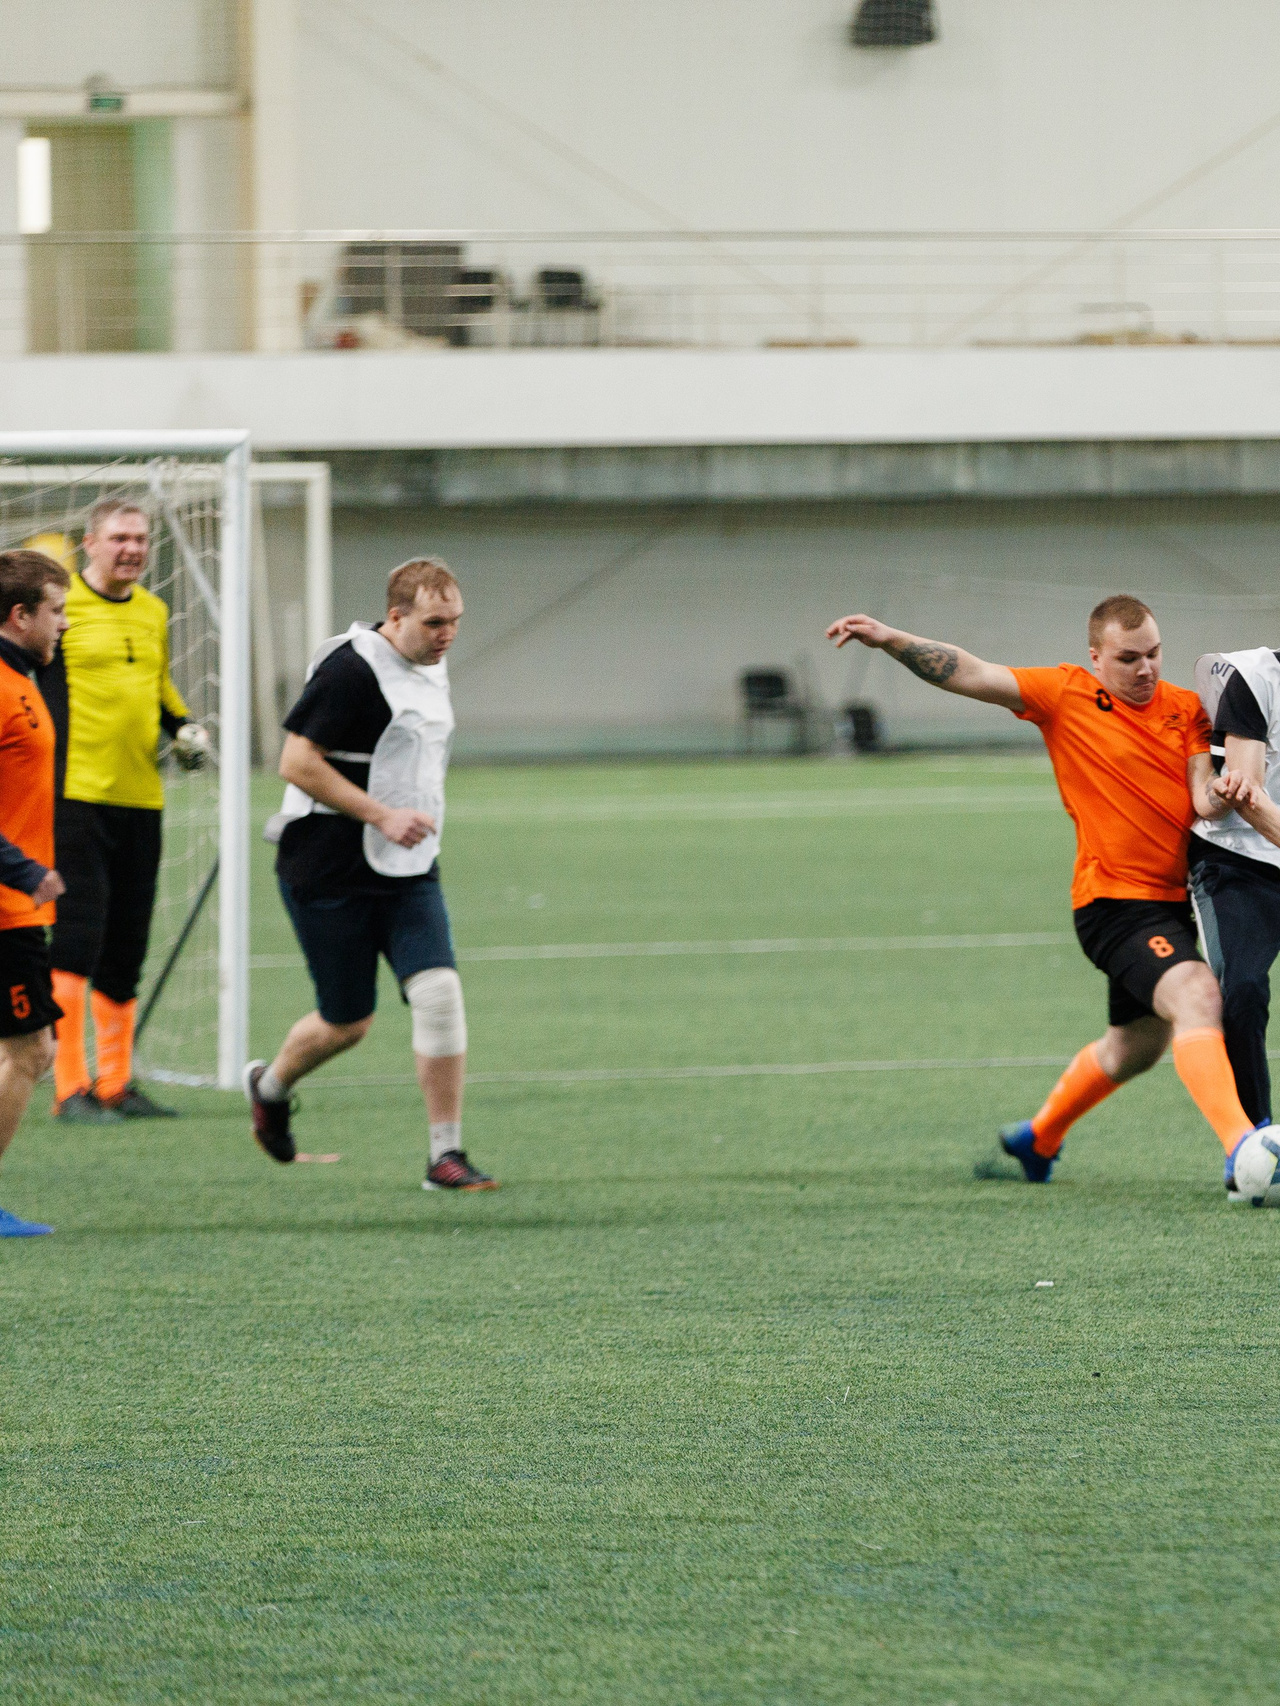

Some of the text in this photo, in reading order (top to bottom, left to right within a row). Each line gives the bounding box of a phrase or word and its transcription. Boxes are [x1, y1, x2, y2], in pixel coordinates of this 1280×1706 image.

[124, 637, 135, 663] 1
[1147, 935, 1175, 958] 8
[10, 984, 31, 1019] 5
